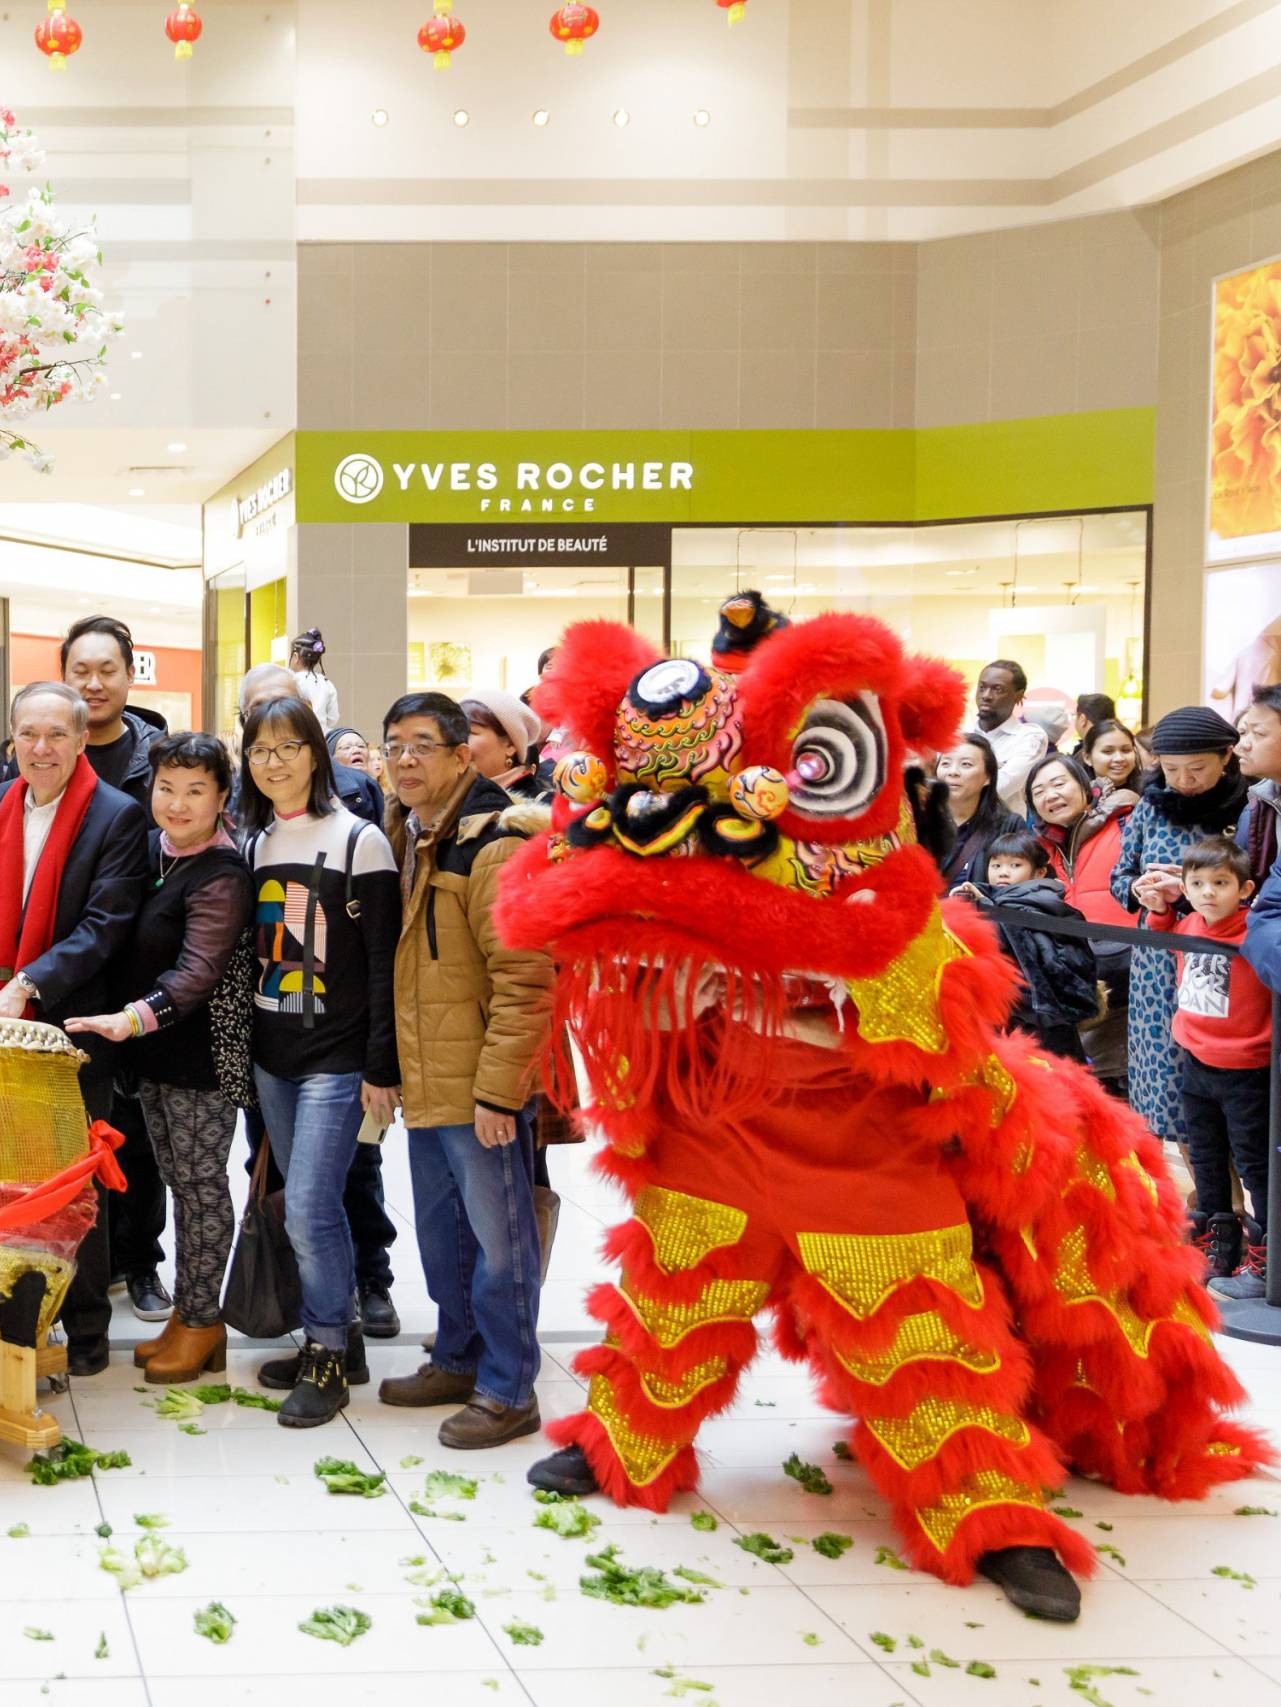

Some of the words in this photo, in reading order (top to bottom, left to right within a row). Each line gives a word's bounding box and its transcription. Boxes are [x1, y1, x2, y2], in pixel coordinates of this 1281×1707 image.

[392, 462, 498, 490] YVES
[516, 462, 694, 490] ROCHER
[480, 498, 595, 512] FRANCE
[467, 538, 537, 553] L'INSTITUT
[538, 538, 556, 552] DE
[557, 535, 608, 552] BEAUTÉ
